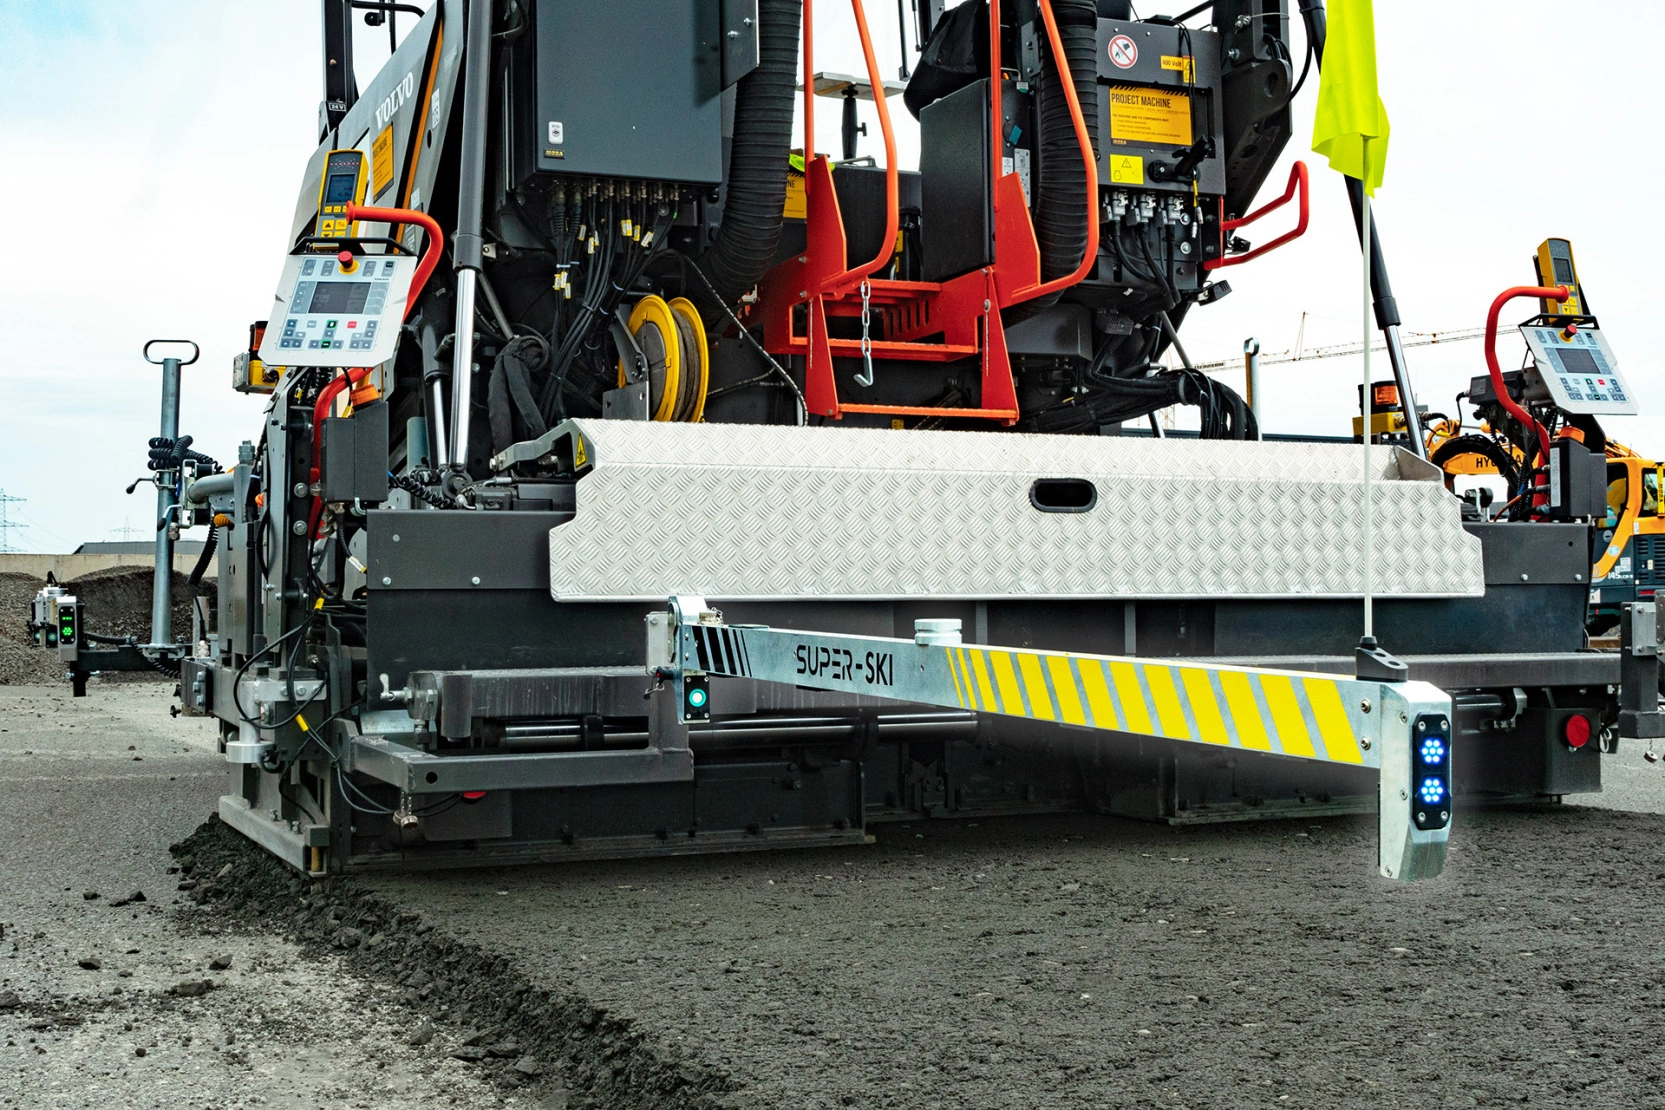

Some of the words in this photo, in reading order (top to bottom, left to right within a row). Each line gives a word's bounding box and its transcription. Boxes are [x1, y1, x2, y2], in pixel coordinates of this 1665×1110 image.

[375, 72, 414, 130] VOLVO
[1111, 93, 1140, 105] PROJECT
[1141, 95, 1171, 108] MACHINE
[796, 644, 893, 686] SUPER-SKI
